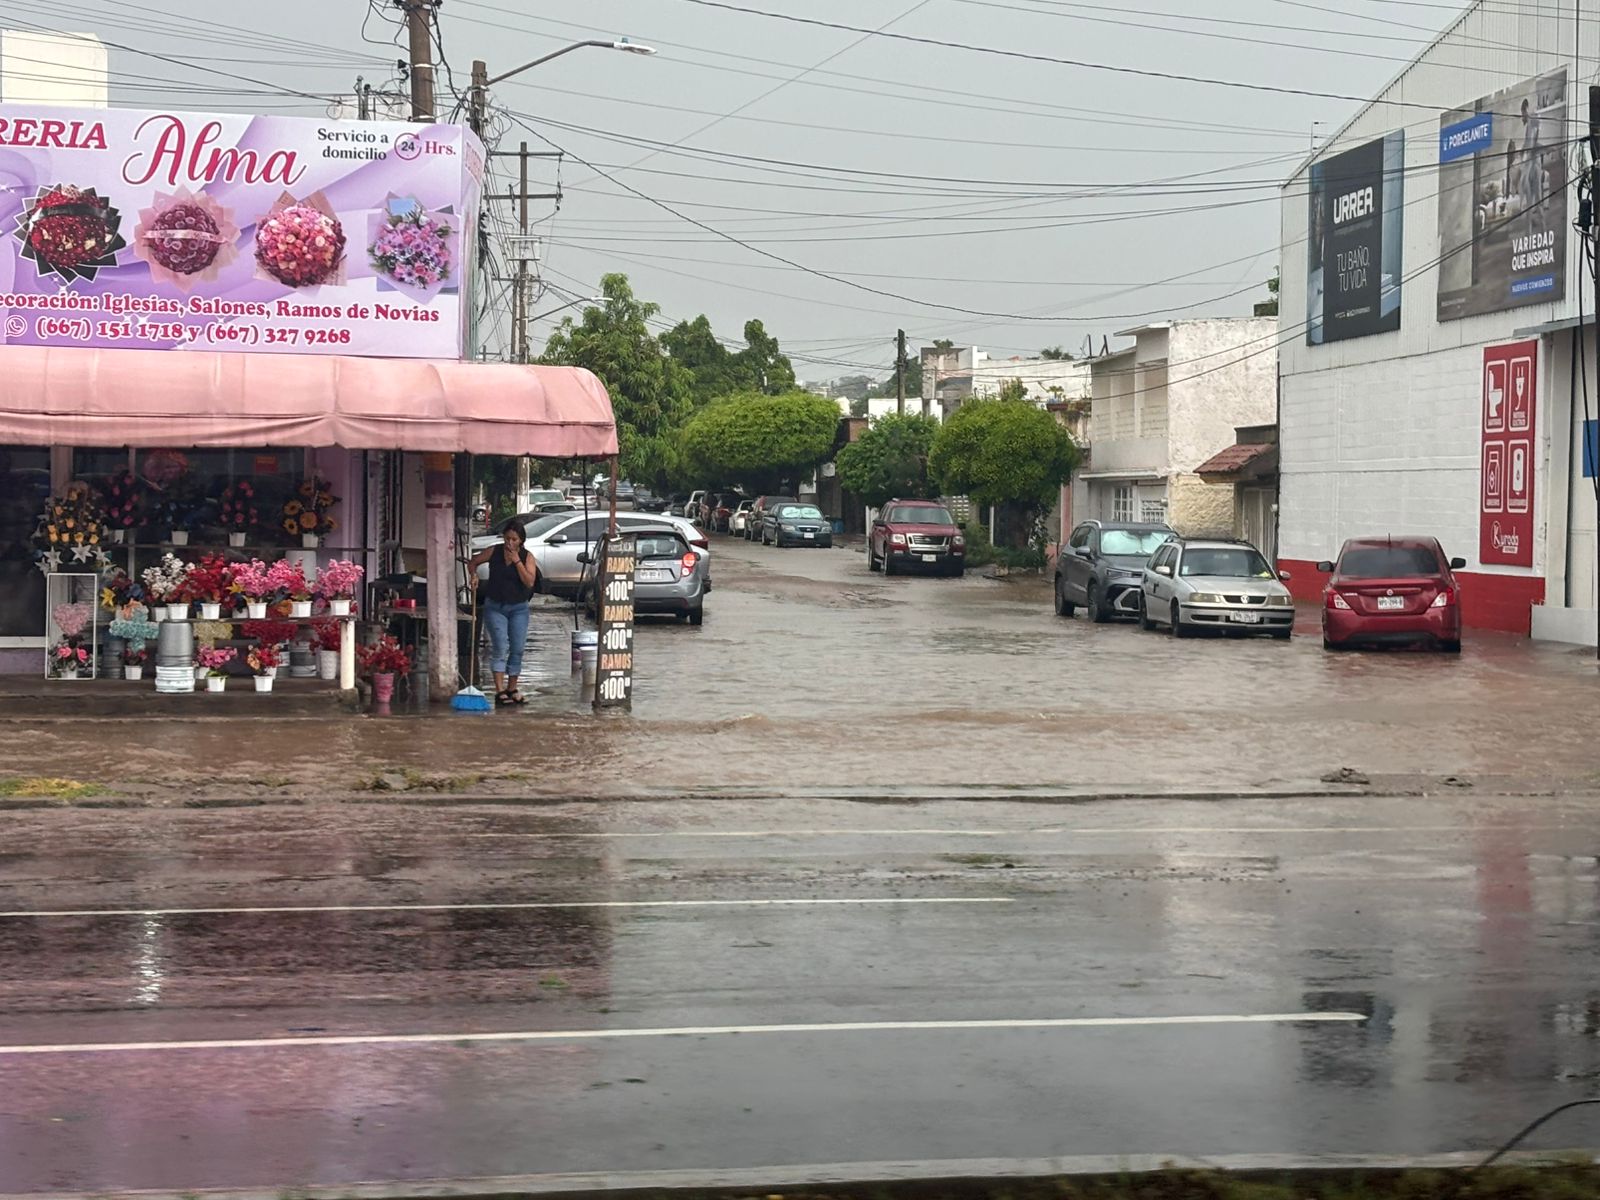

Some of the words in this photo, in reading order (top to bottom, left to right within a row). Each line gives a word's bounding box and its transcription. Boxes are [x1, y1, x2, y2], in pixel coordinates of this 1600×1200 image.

[317, 127, 376, 143] Servicio
[380, 133, 389, 144] a
[122, 115, 307, 186] Alma
[322, 146, 387, 161] domicilio
[401, 141, 415, 152] 24
[425, 140, 457, 155] Hrs.
[1333, 186, 1373, 224] URREA
[1512, 230, 1555, 254] VARIEDAD
[1337, 252, 1347, 272] TU
[1511, 254, 1526, 271] QUE
[1526, 248, 1555, 269] INSPIRA
[1339, 272, 1348, 292] TU
[1349, 268, 1368, 290] VIDA
[104, 294, 184, 315] Iglesias,
[190, 297, 271, 319] Salones,
[276, 300, 342, 318] Ramos
[347, 303, 370, 319] de
[374, 304, 440, 322] Novias
[37, 318, 91, 339] (667)
[97, 322, 131, 338] 151
[138, 323, 183, 340] 1718
[187, 328, 200, 342] y
[206, 324, 259, 345] (667)
[264, 328, 299, 345] 327
[304, 329, 351, 345] 9268
[607, 557, 634, 573] RAMOS
[604, 605, 633, 621] RAMOS
[601, 653, 631, 670] RAMOS
